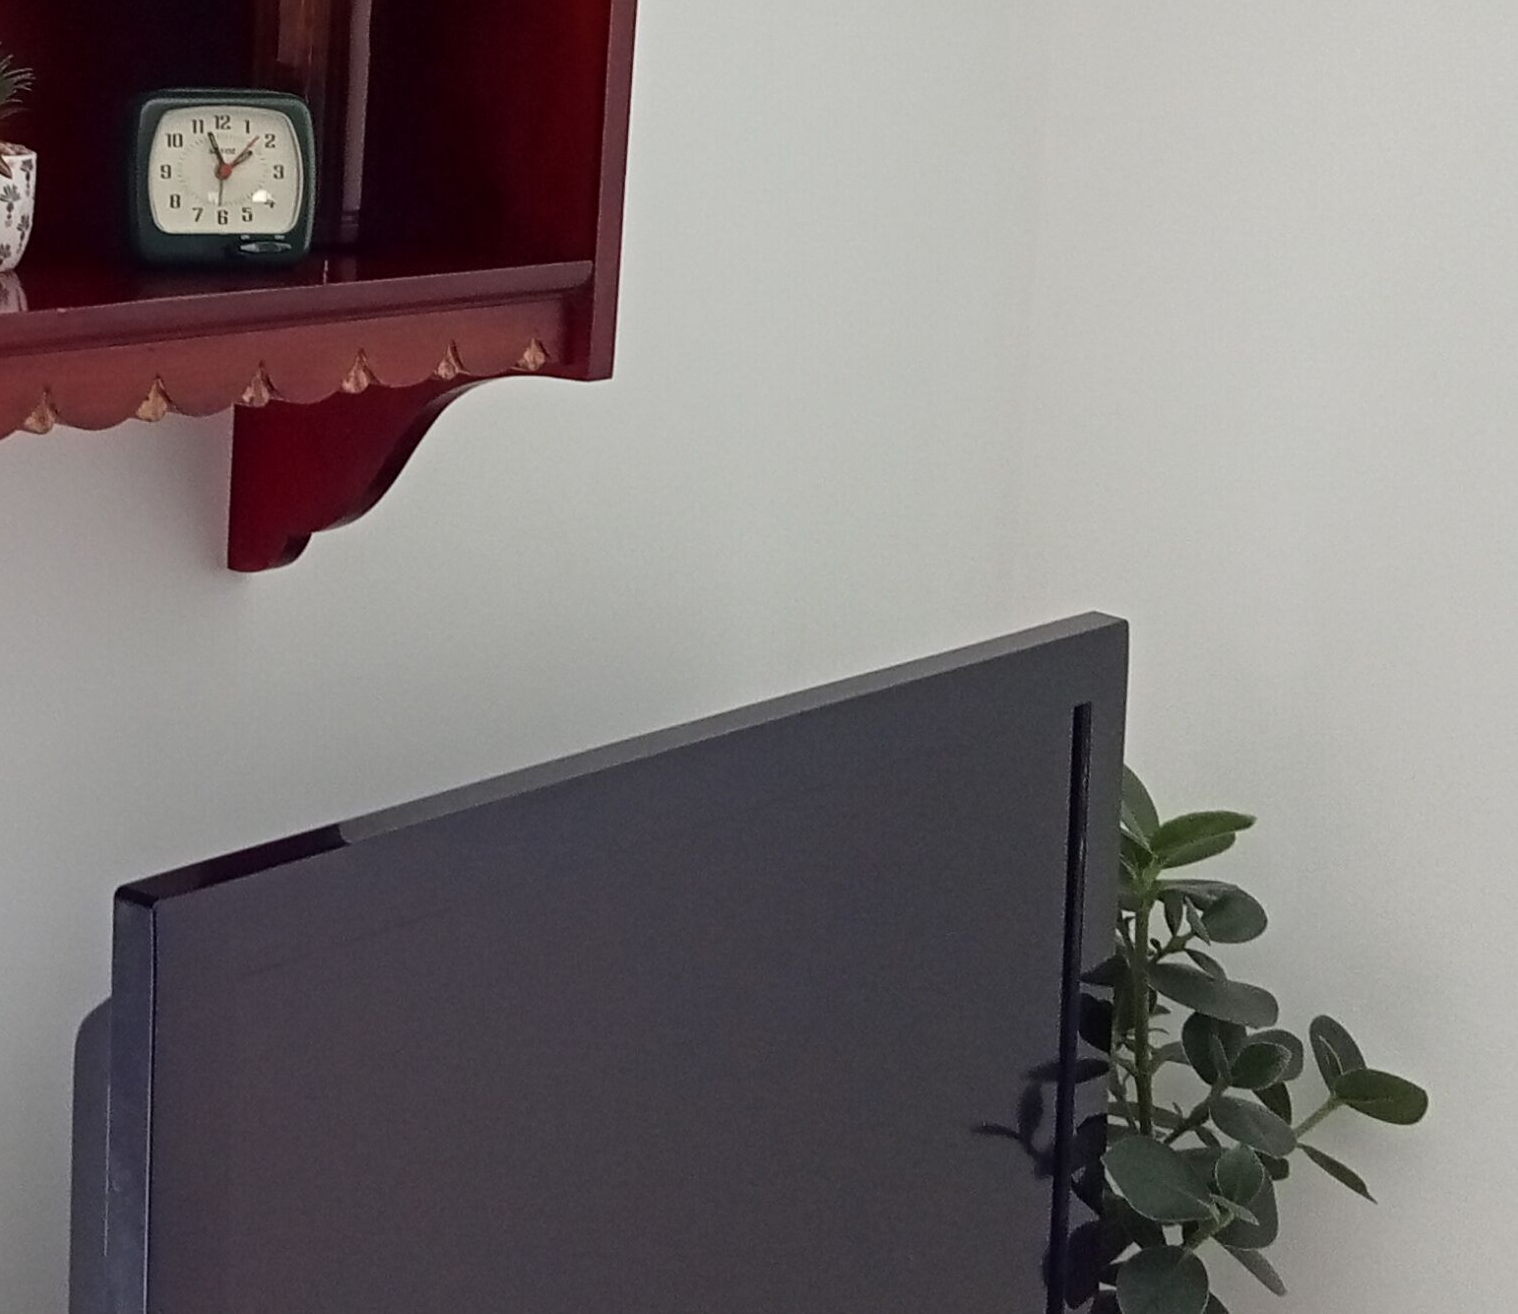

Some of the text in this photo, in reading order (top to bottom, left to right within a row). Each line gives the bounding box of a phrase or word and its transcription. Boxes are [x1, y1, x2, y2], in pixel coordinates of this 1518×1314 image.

[192, 119, 204, 134] 11
[214, 115, 231, 130] 12
[245, 120, 250, 134] 1
[167, 133, 183, 147] 10
[265, 134, 276, 148] 2
[160, 164, 172, 179] 9
[273, 165, 284, 179] 3
[170, 194, 181, 208] 8
[192, 207, 204, 222] 7
[217, 209, 228, 225] 6
[242, 207, 253, 222] 5
